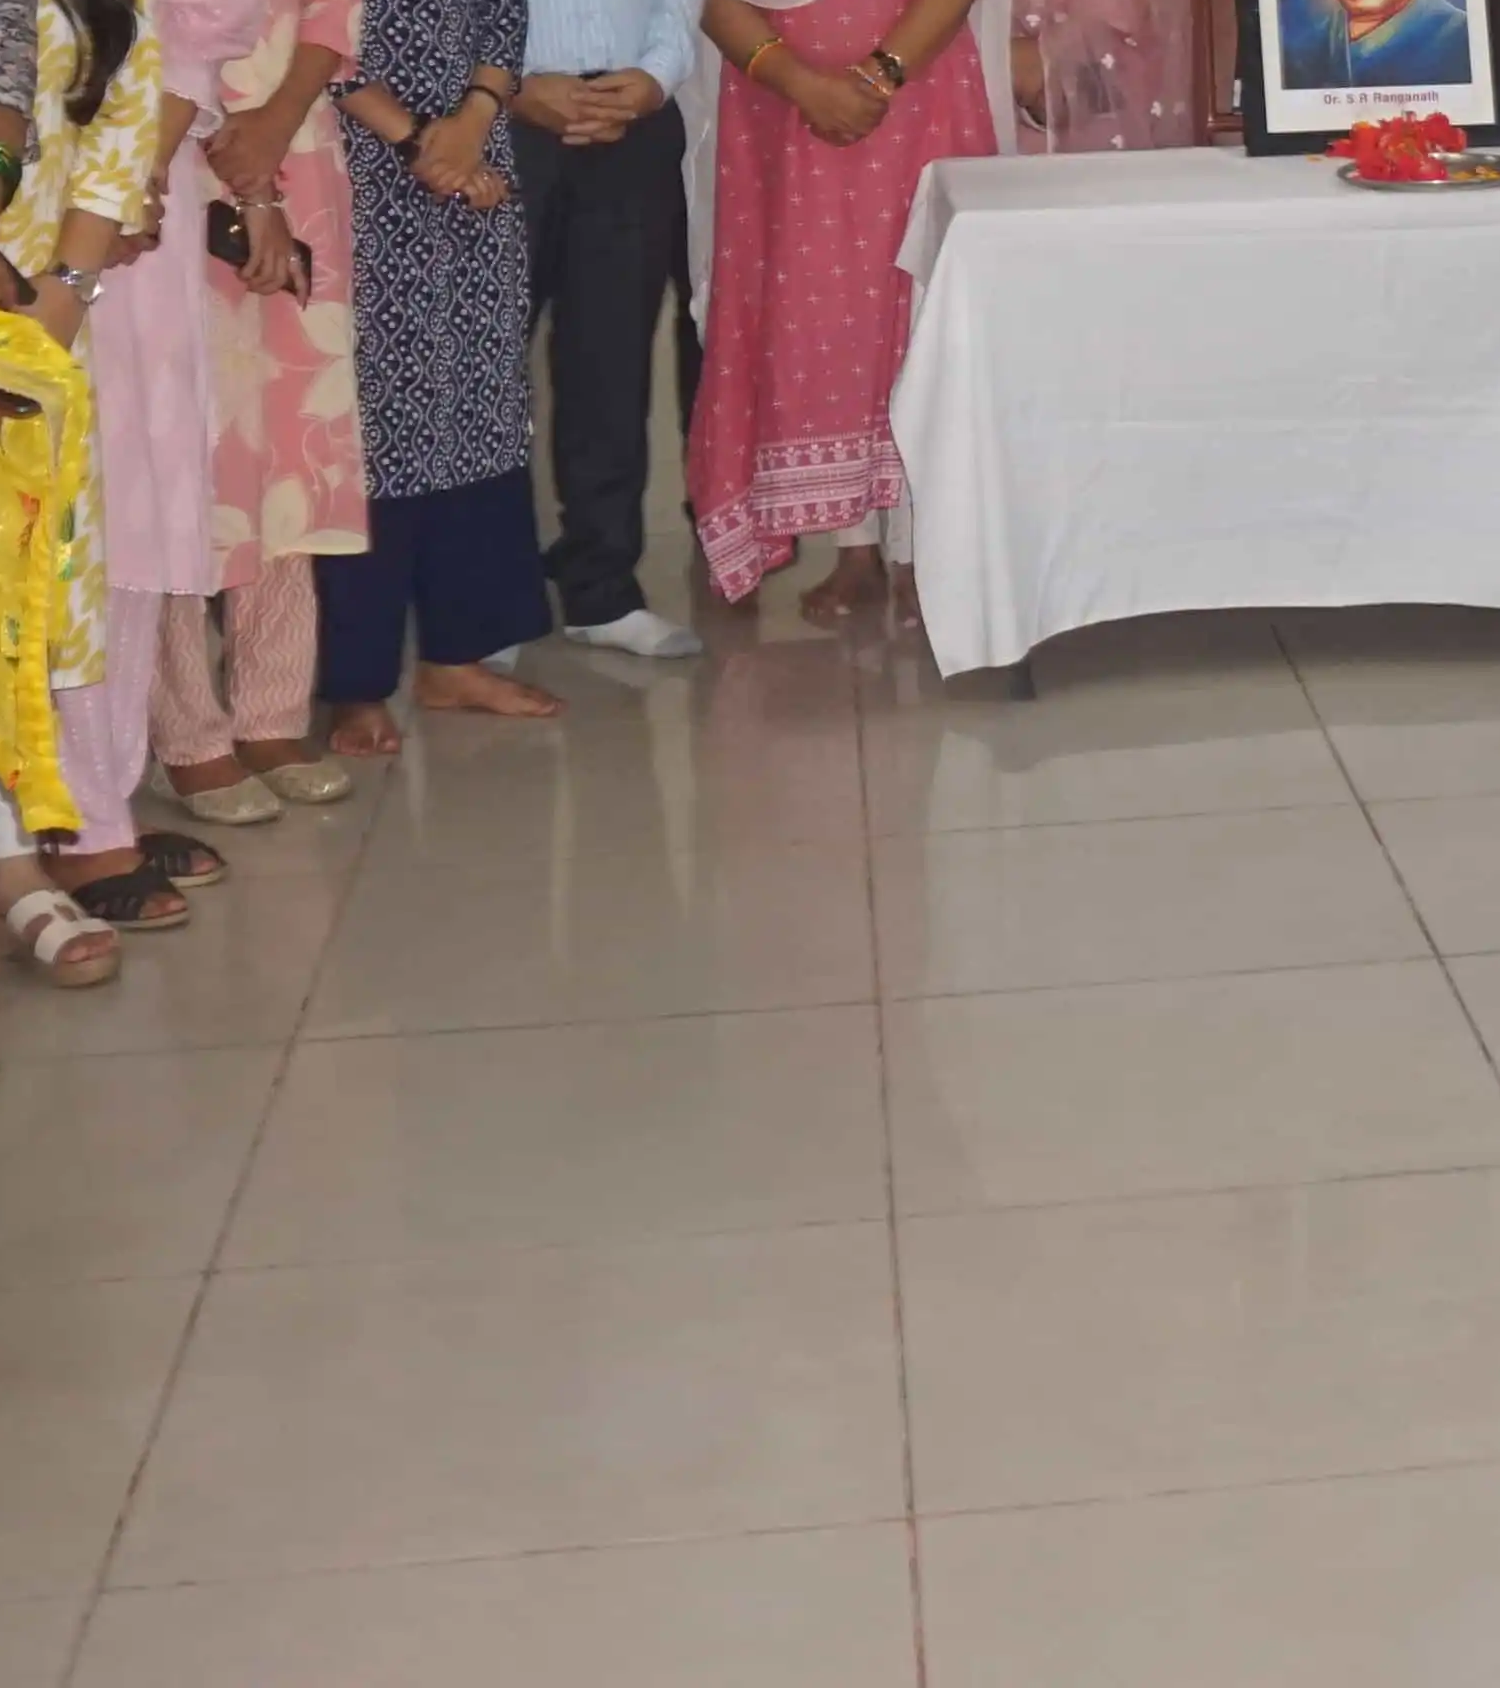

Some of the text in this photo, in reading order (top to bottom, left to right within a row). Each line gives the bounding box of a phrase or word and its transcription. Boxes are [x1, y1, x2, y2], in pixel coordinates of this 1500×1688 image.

[1323, 93, 1341, 105] Dr.
[1346, 93, 1355, 104] S
[1359, 92, 1369, 104] R
